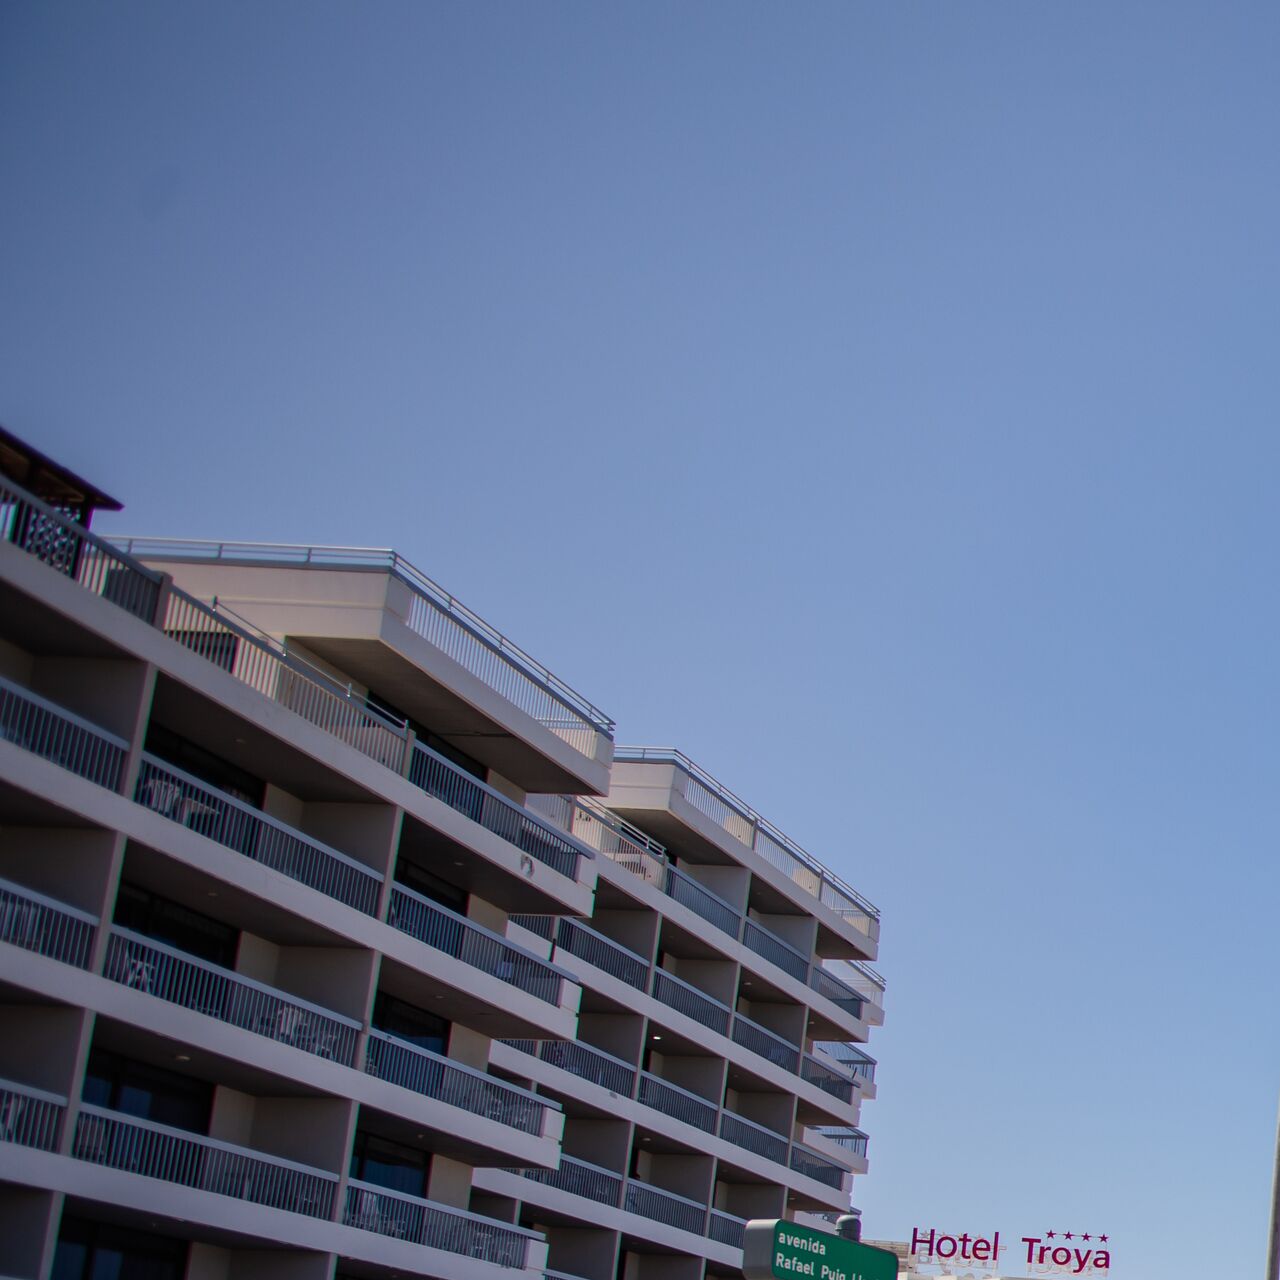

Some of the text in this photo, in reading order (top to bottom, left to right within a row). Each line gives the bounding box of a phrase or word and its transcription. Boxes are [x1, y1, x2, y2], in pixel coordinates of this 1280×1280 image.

[778, 1232, 826, 1255] avenida
[911, 1227, 1110, 1273] Hotel Troya
[776, 1252, 815, 1276] Rafael
